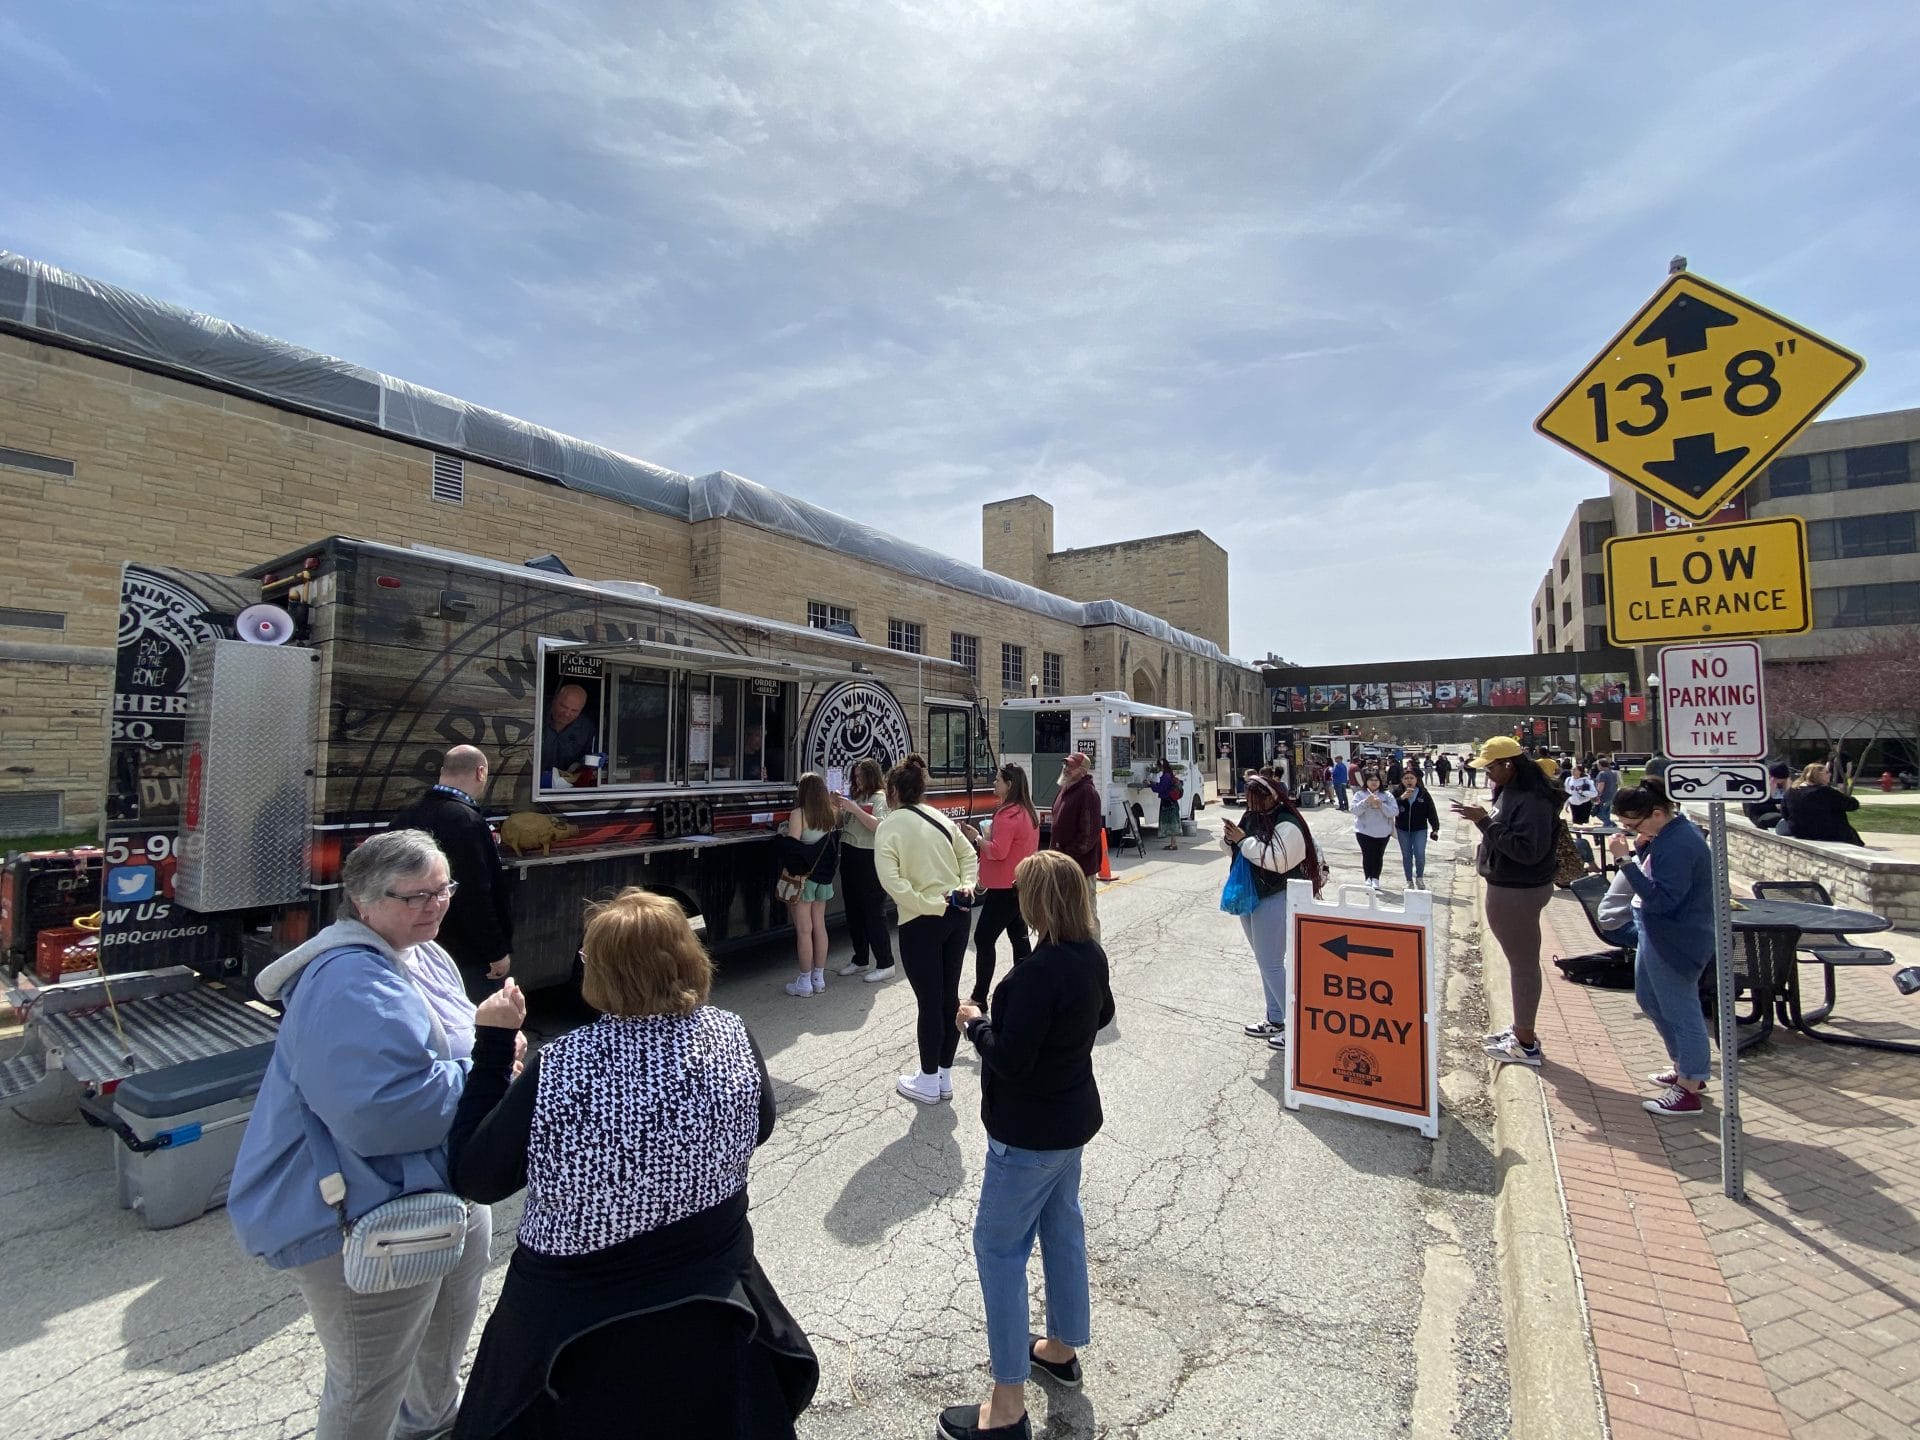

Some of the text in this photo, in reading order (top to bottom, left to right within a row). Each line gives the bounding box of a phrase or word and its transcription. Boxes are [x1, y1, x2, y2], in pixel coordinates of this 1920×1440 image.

[1649, 545, 1757, 588] LOW
[1628, 589, 1788, 622] CLEARANCE
[140, 639, 170, 656] BAD
[1691, 657, 1728, 679] NO
[754, 679, 777, 687] ORDER
[1669, 684, 1755, 708] PARKING
[814, 706, 840, 768] AWARD
[841, 692, 892, 720] WINNING
[1694, 711, 1732, 727] ANY
[1691, 731, 1738, 746] TIME
[662, 801, 712, 837] BBQ
[106, 835, 178, 864] 5-9
[1323, 973, 1394, 1006] BBQ
[1304, 1006, 1413, 1045] TODAY
